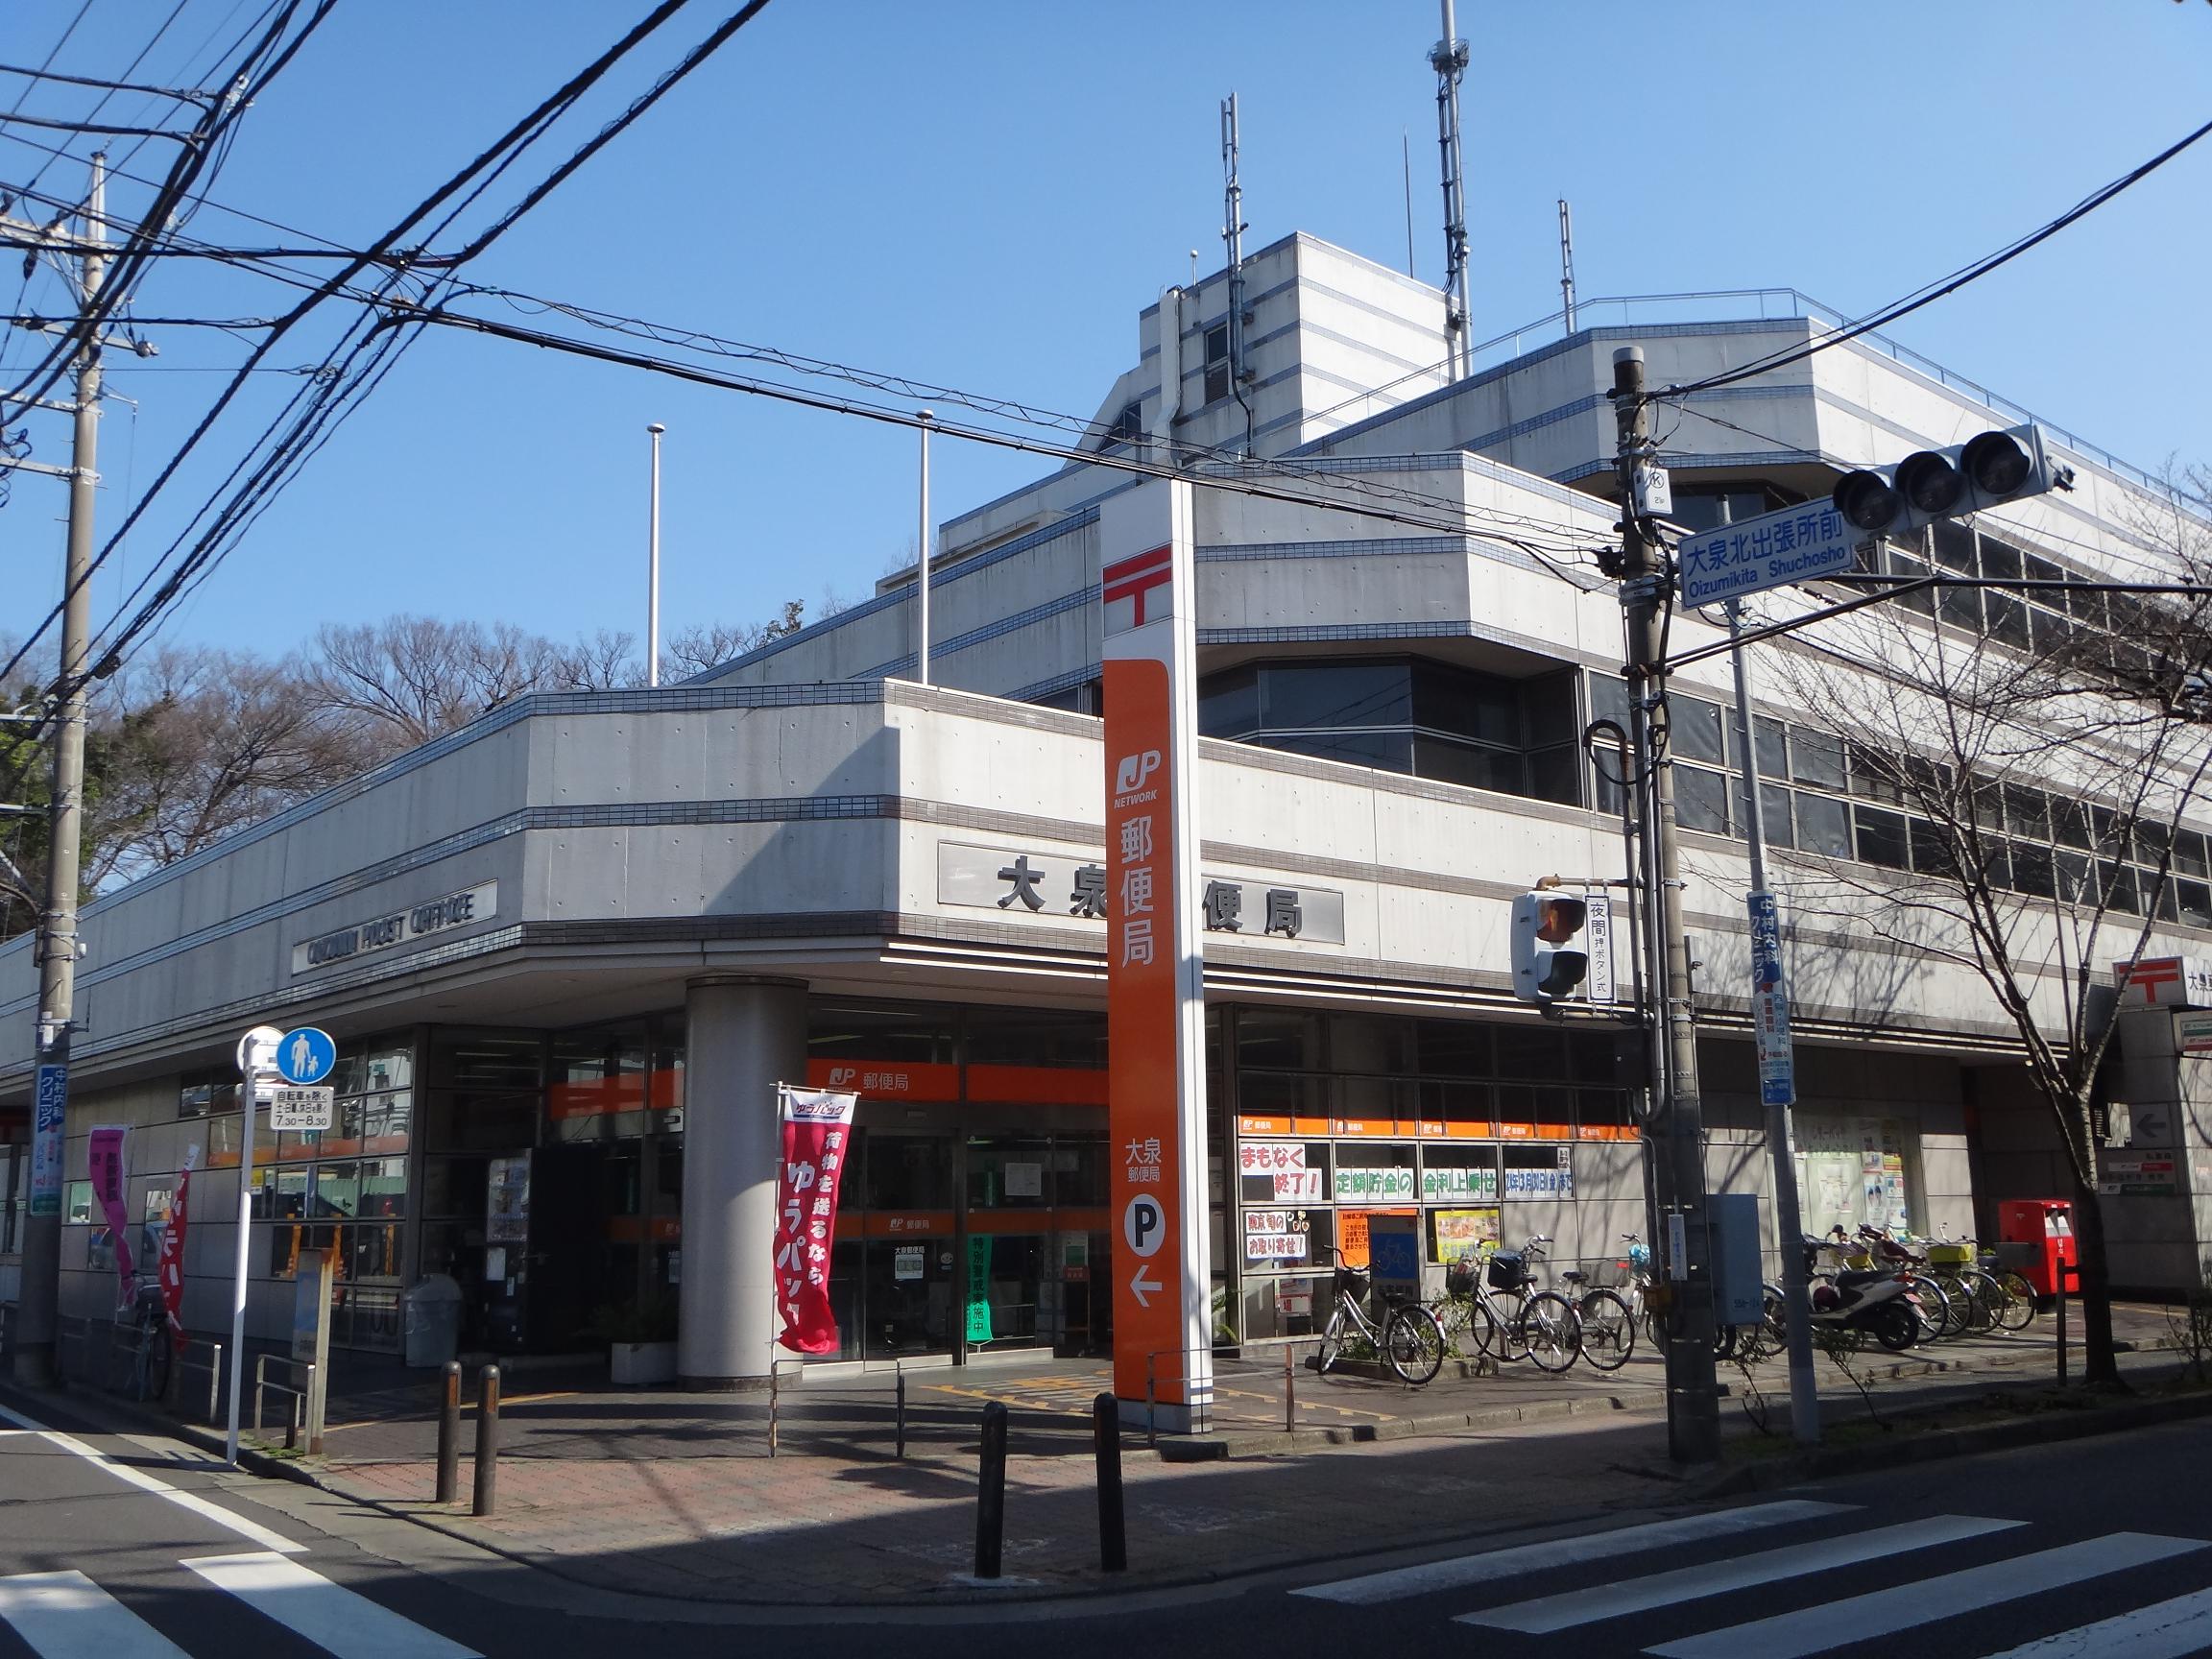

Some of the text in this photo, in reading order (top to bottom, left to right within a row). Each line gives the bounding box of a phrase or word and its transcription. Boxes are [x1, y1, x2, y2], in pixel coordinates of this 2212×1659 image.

[1687, 509, 1843, 577] 大泉北出張所前
[1688, 544, 1845, 599] Oizumikita Shuchosho
[1116, 750, 1162, 795] JP
[1114, 789, 1158, 809] NETWORK
[1120, 815, 1154, 969] 郵便局
[1590, 902, 1607, 993] 夜間押ボタン式
[1760, 898, 1779, 965] 中村内科
[54, 1068, 66, 1119] 中村内科
[277, 1091, 327, 1101] 自転車を除く
[863, 1072, 908, 1091] 郵便局
[38, 1076, 54, 1127] クリニック
[796, 1100, 846, 1116] ゆうパック
[1125, 1138, 1162, 1165] 大泉
[1241, 1147, 1305, 1169] まもなく
[1128, 1166, 1160, 1183] 郵便局
[1275, 1173, 1317, 1194] 終了！
[1336, 1171, 1412, 1193] 定額貯金の
[1424, 1172, 1496, 1193] 金利上乗せ
[807, 1131, 842, 1286] 荷物を送るなら
[1135, 1203, 1157, 1248] P
